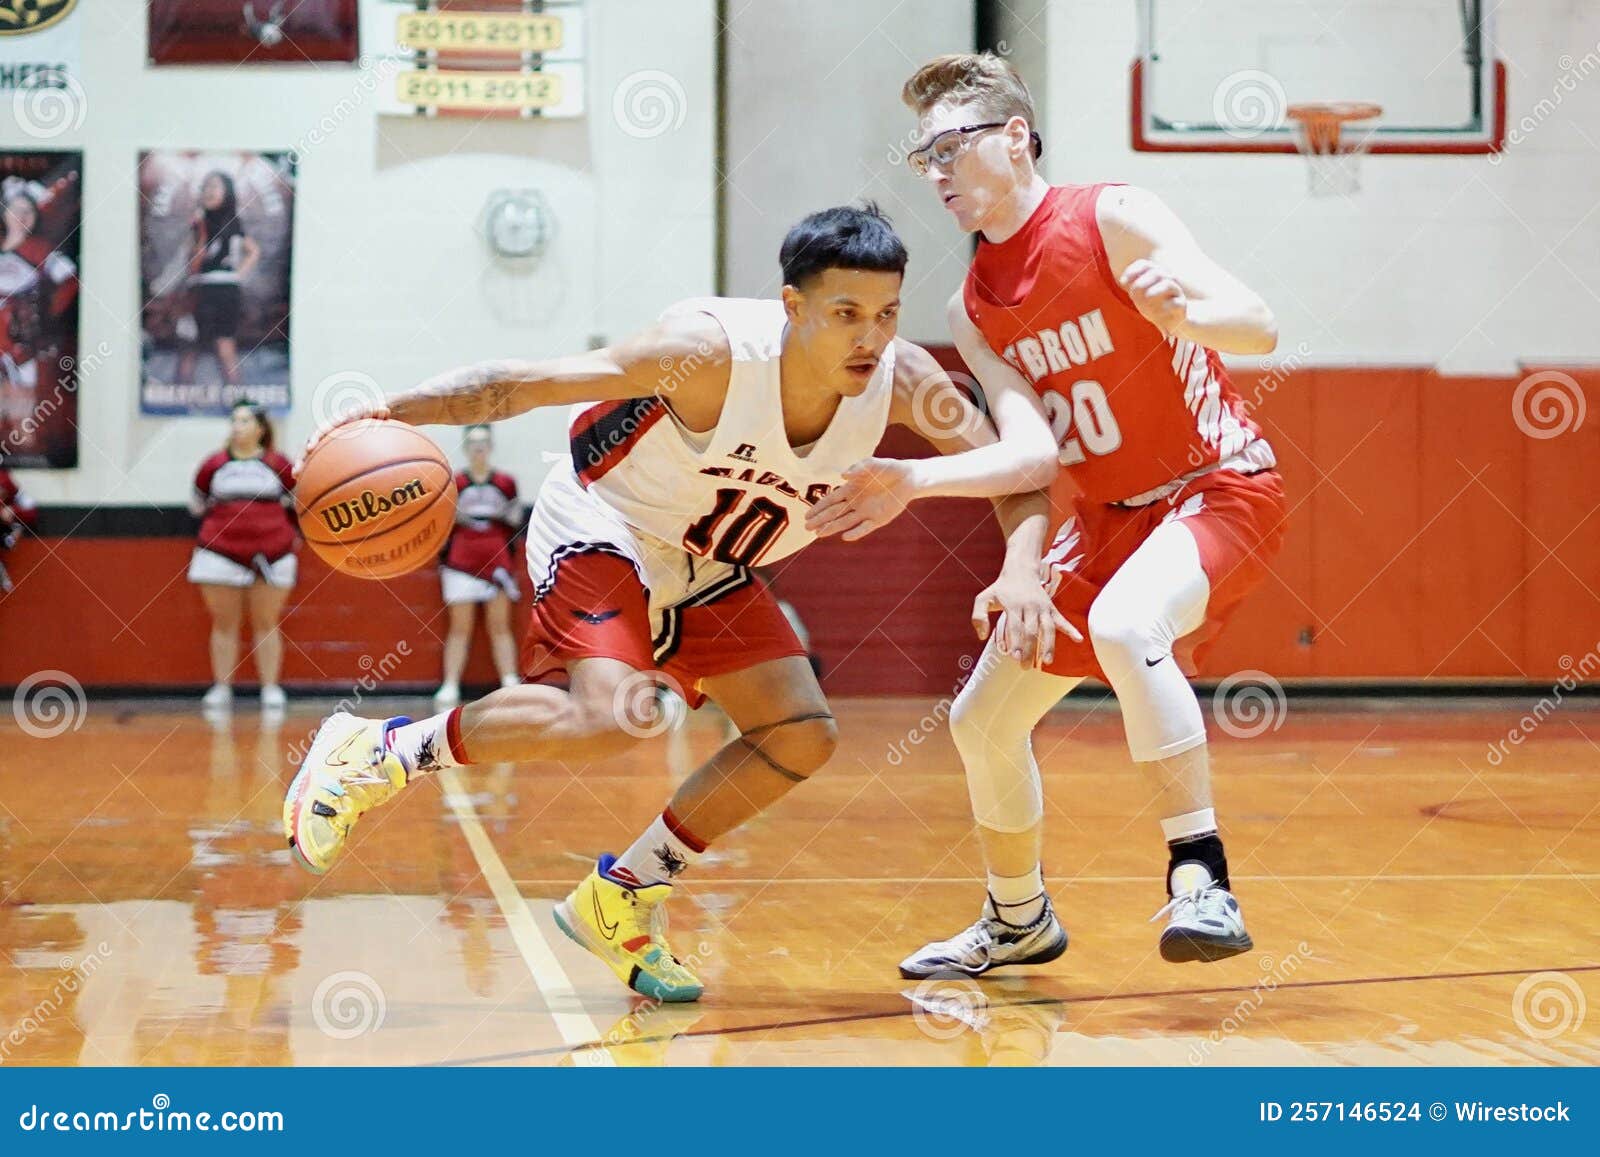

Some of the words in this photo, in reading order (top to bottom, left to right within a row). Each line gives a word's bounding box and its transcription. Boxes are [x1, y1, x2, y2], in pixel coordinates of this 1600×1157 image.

[1041, 380, 1122, 466] 20
[320, 479, 432, 534] Wilson
[682, 488, 789, 567] 10
[345, 518, 438, 567] EVOLUTION
